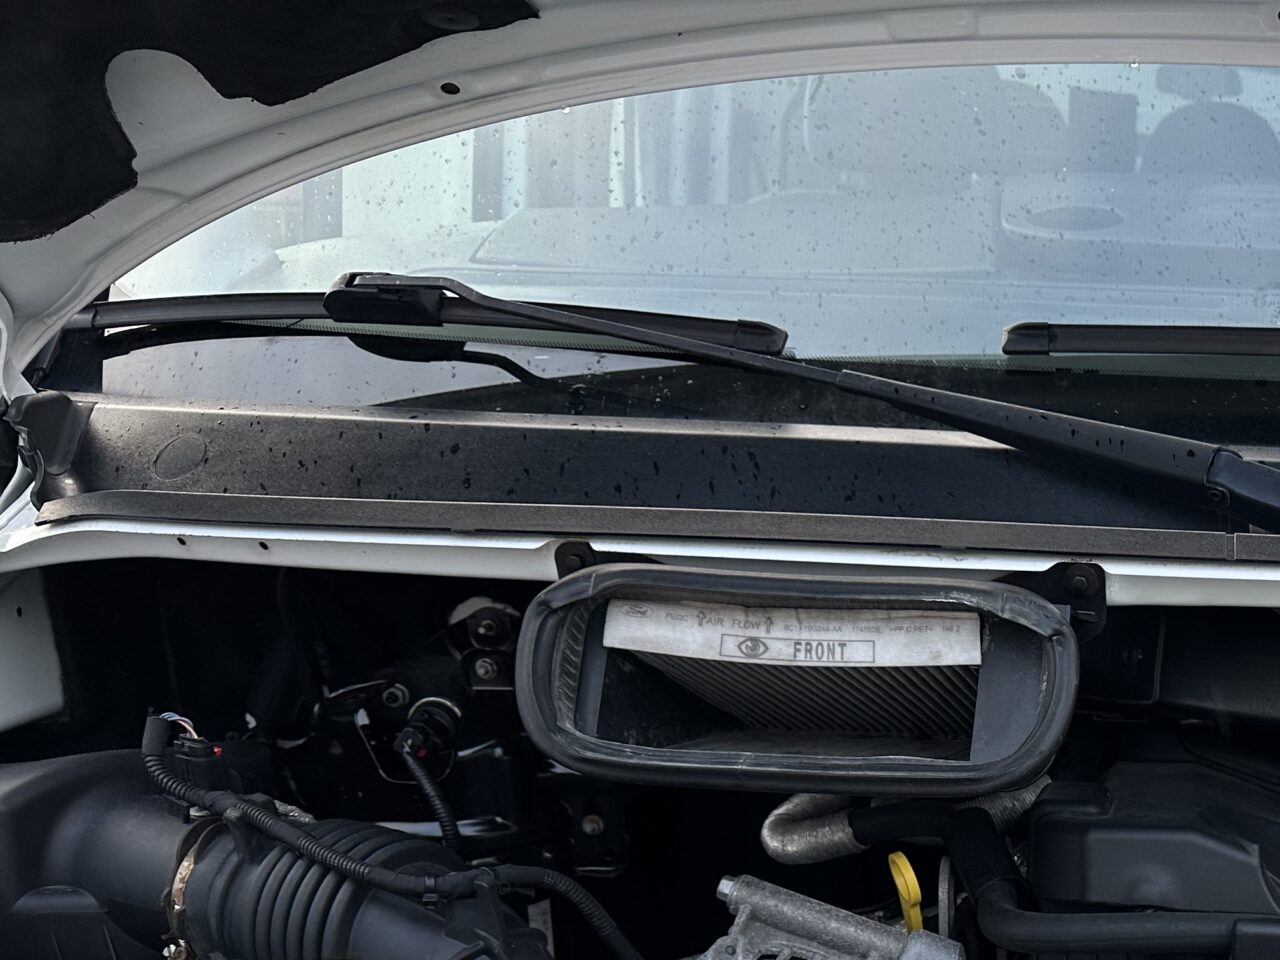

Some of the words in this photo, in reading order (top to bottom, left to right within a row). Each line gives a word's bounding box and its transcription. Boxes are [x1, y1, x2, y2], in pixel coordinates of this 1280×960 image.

[706, 617, 724, 627] AIR
[731, 620, 762, 630] FLOW
[793, 641, 847, 661] FRONT
